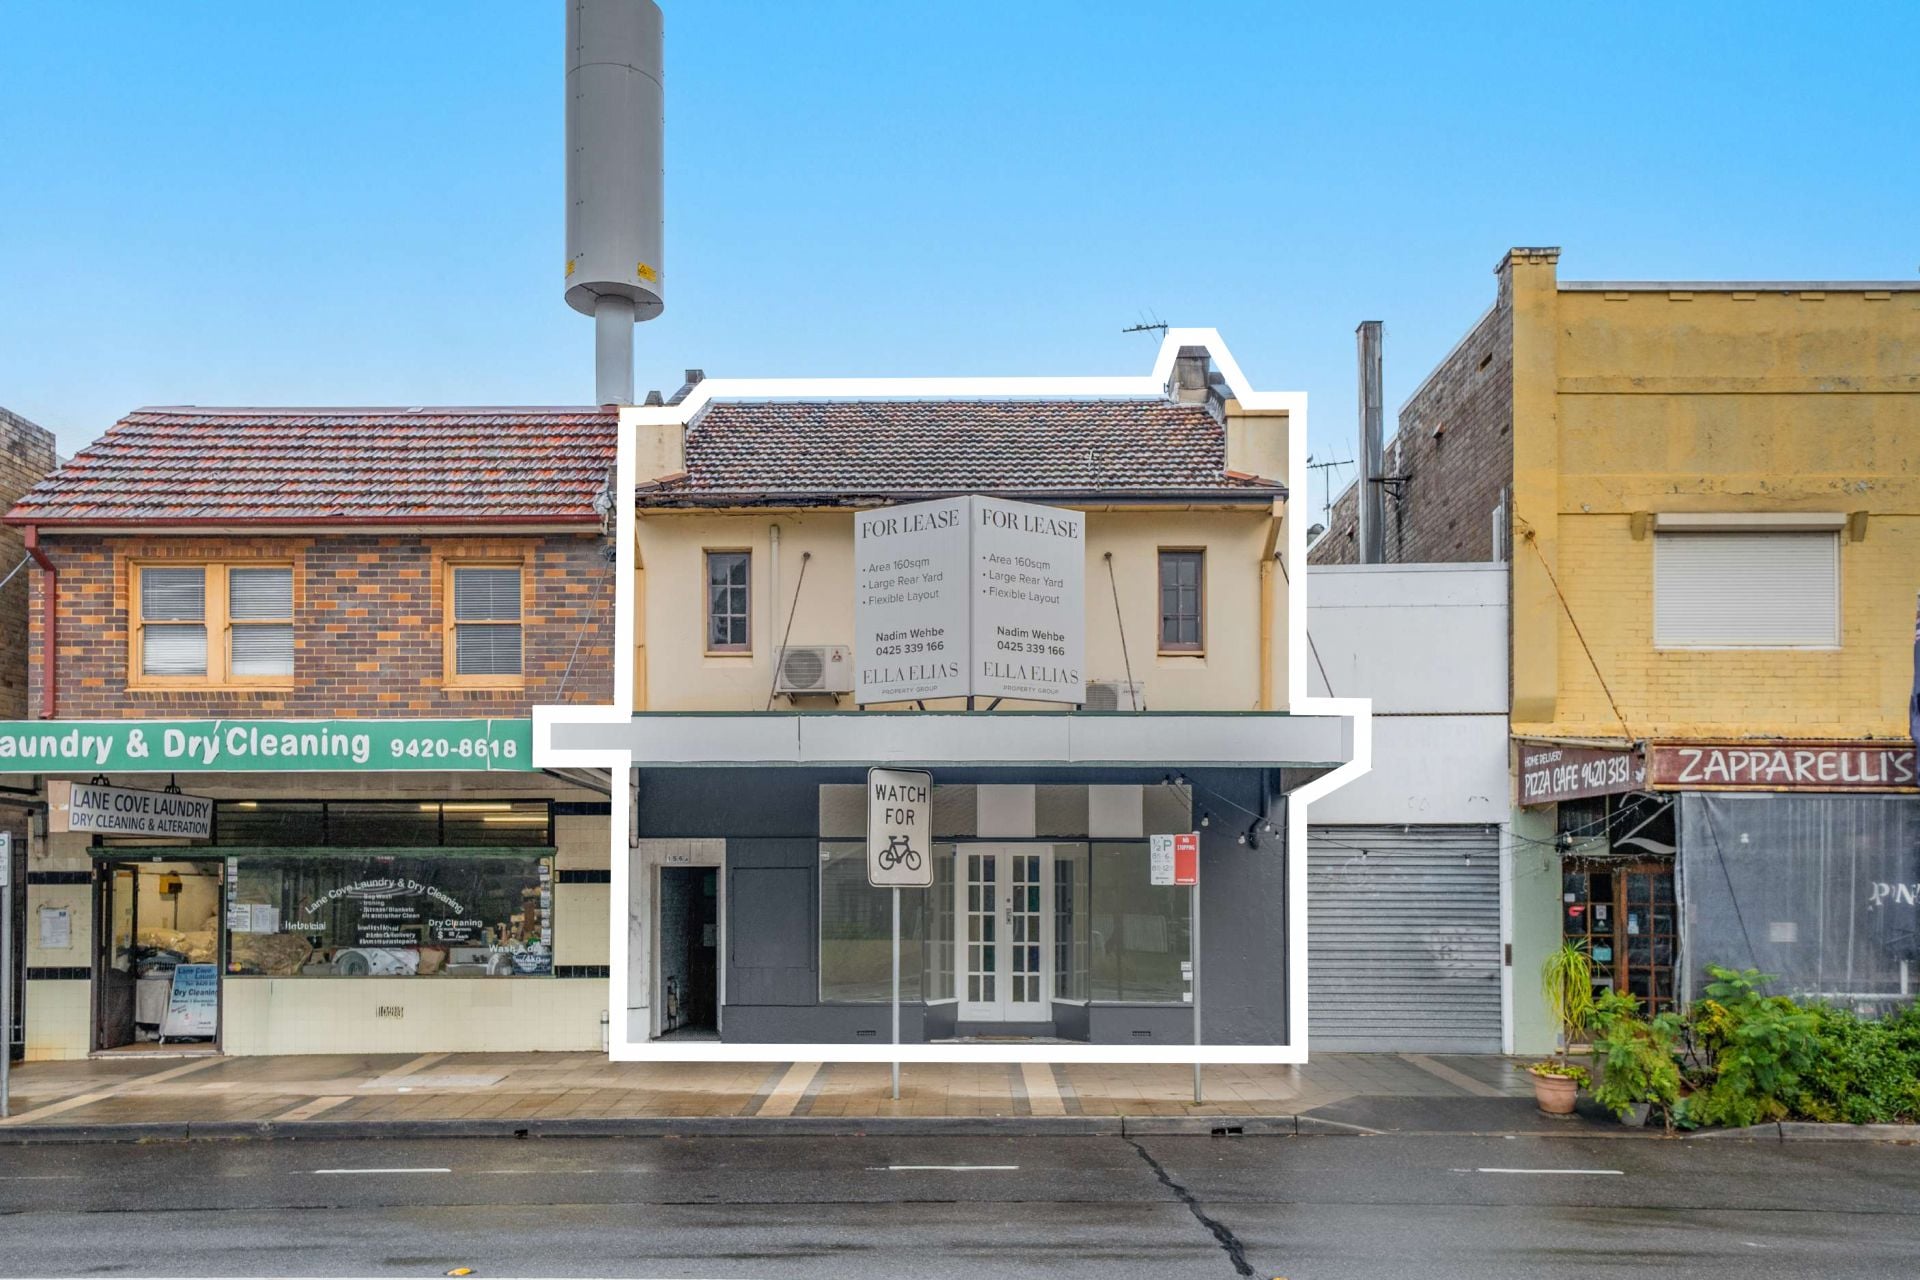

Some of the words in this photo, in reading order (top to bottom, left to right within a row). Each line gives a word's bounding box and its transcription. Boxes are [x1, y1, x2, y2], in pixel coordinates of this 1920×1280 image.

[862, 518, 898, 539] FOR
[903, 509, 960, 533] LEASE
[982, 508, 1019, 529] FOR
[1024, 514, 1078, 539] LEASE
[869, 561, 891, 573] Area
[894, 557, 930, 571] 160sqm
[989, 553, 1012, 566] Area
[1015, 557, 1050, 571] 160sqm
[869, 577, 895, 590] Large
[898, 576, 919, 587] Rear
[922, 572, 943, 583] Yard
[989, 570, 1016, 583] Large
[1019, 575, 1040, 586] Rear
[1043, 577, 1064, 589] Yard
[869, 592, 904, 606] Flexible
[907, 590, 939, 602] Layout
[989, 586, 1026, 600] Flexible
[1029, 593, 1060, 605] Layout
[876, 631, 907, 642] Nadim
[910, 627, 944, 639] Wehbe
[997, 626, 1029, 638] Nadim
[1032, 629, 1065, 642] Wehbe
[876, 645, 901, 656] 0425
[904, 643, 924, 654] 339
[927, 641, 944, 652] 166
[997, 640, 1023, 652] 0425
[1026, 643, 1045, 654] 339
[1049, 645, 1065, 656] 166
[863, 667, 905, 685] ELLA
[909, 662, 959, 681] ELIAS
[984, 661, 1026, 680] ELLA
[1031, 665, 1079, 685] ELIAS
[881, 687, 914, 695] PROPERTY
[916, 685, 938, 693] GROUP
[1003, 685, 1035, 694] PROPERTY
[1038, 687, 1059, 695] GROUP
[126, 729, 149, 758] &
[164, 728, 220, 765] Dry
[226, 727, 370, 763] Cleaning
[390, 738, 517, 758] 9420-8618
[1525, 755, 1540, 768] HOME
[1540, 751, 1563, 764] DELIVERY
[1678, 750, 1913, 782] ZAPPARELLI'S
[1525, 768, 1551, 797] PIZZA
[1553, 764, 1578, 791] CAFE
[1581, 760, 1606, 788] 9420
[1608, 755, 1629, 785] 3131
[875, 783, 926, 803] WATCH
[73, 789, 110, 811] LANE
[114, 795, 149, 814] COVE
[153, 797, 209, 819] LAUNDRY
[72, 812, 93, 827] DRY
[96, 814, 145, 830] CLEANING
[148, 818, 155, 830] &
[157, 820, 208, 834] ALTERATION
[885, 808, 914, 825] FOR
[304, 896, 329, 914] Lane
[328, 884, 353, 898] Cove
[354, 877, 395, 890] Laundry
[397, 878, 405, 888] &
[407, 880, 425, 894] Dry
[427, 886, 465, 915] Cleaning
[428, 919, 444, 928] Dry
[445, 918, 483, 928] Cleaning
[174, 989, 187, 997] Dry
